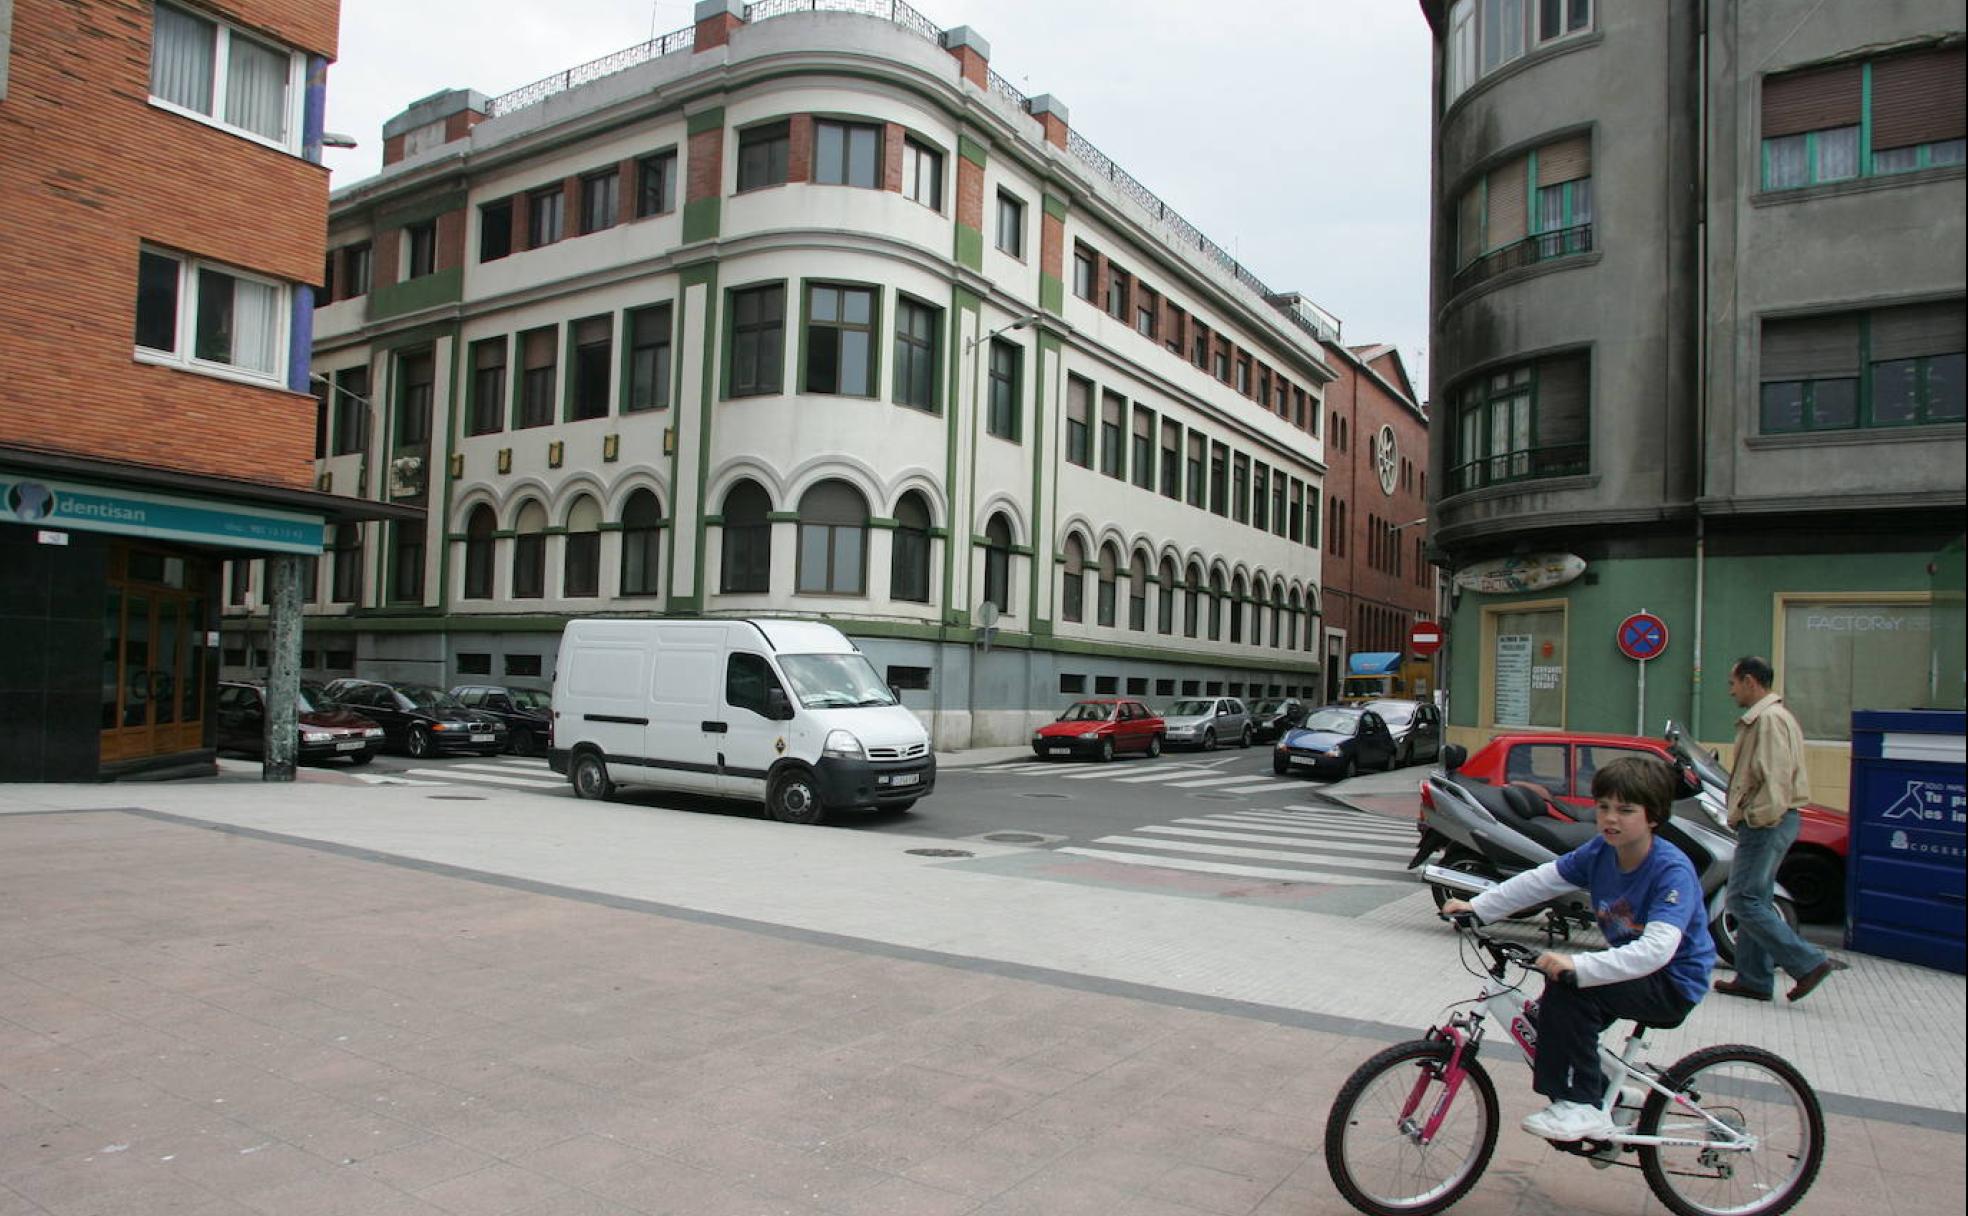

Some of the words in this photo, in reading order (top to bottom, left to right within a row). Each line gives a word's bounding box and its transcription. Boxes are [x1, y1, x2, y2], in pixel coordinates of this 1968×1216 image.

[60, 497, 146, 521] dentisan
[1925, 791, 1942, 804] Tu
[1924, 809, 1943, 820] es
